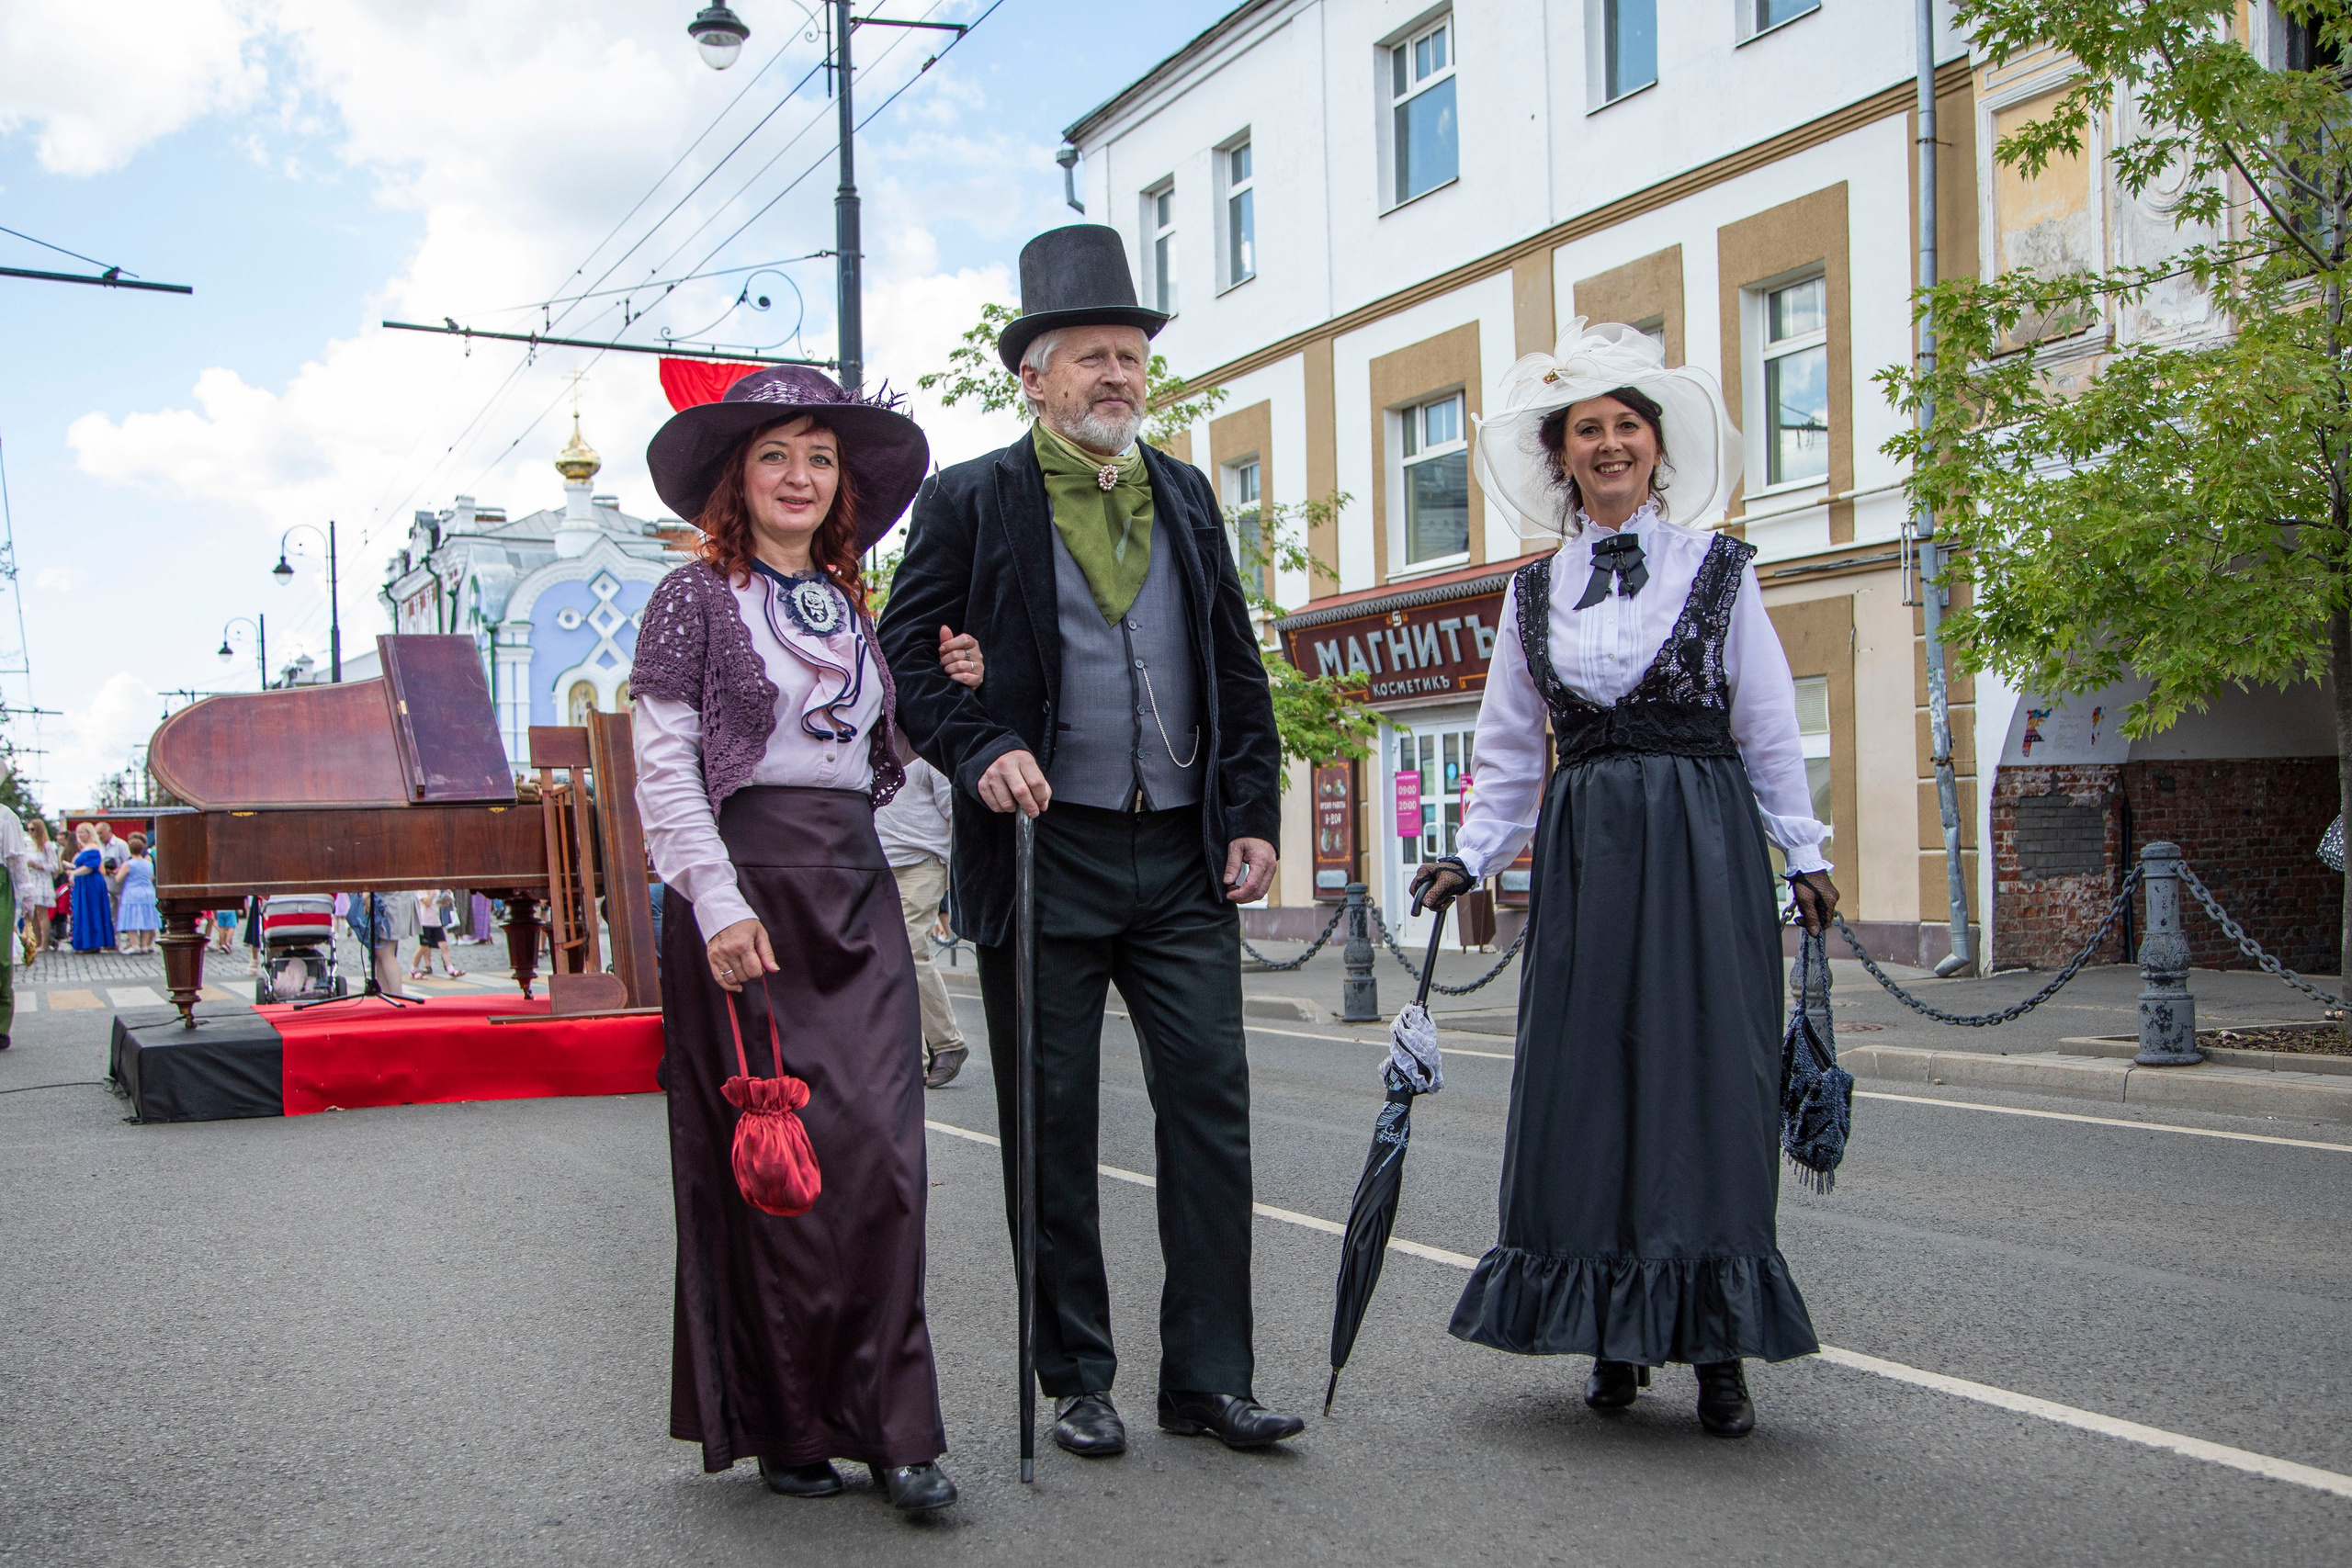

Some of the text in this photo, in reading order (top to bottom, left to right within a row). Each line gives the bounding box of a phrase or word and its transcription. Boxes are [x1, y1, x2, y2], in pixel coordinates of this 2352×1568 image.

[1314, 615, 1496, 677] МАГНИТЪ
[1373, 675, 1451, 696] КОСМЕТИКЪ
[1398, 784, 1417, 795] 09:00
[1399, 800, 1417, 810] 20:00
